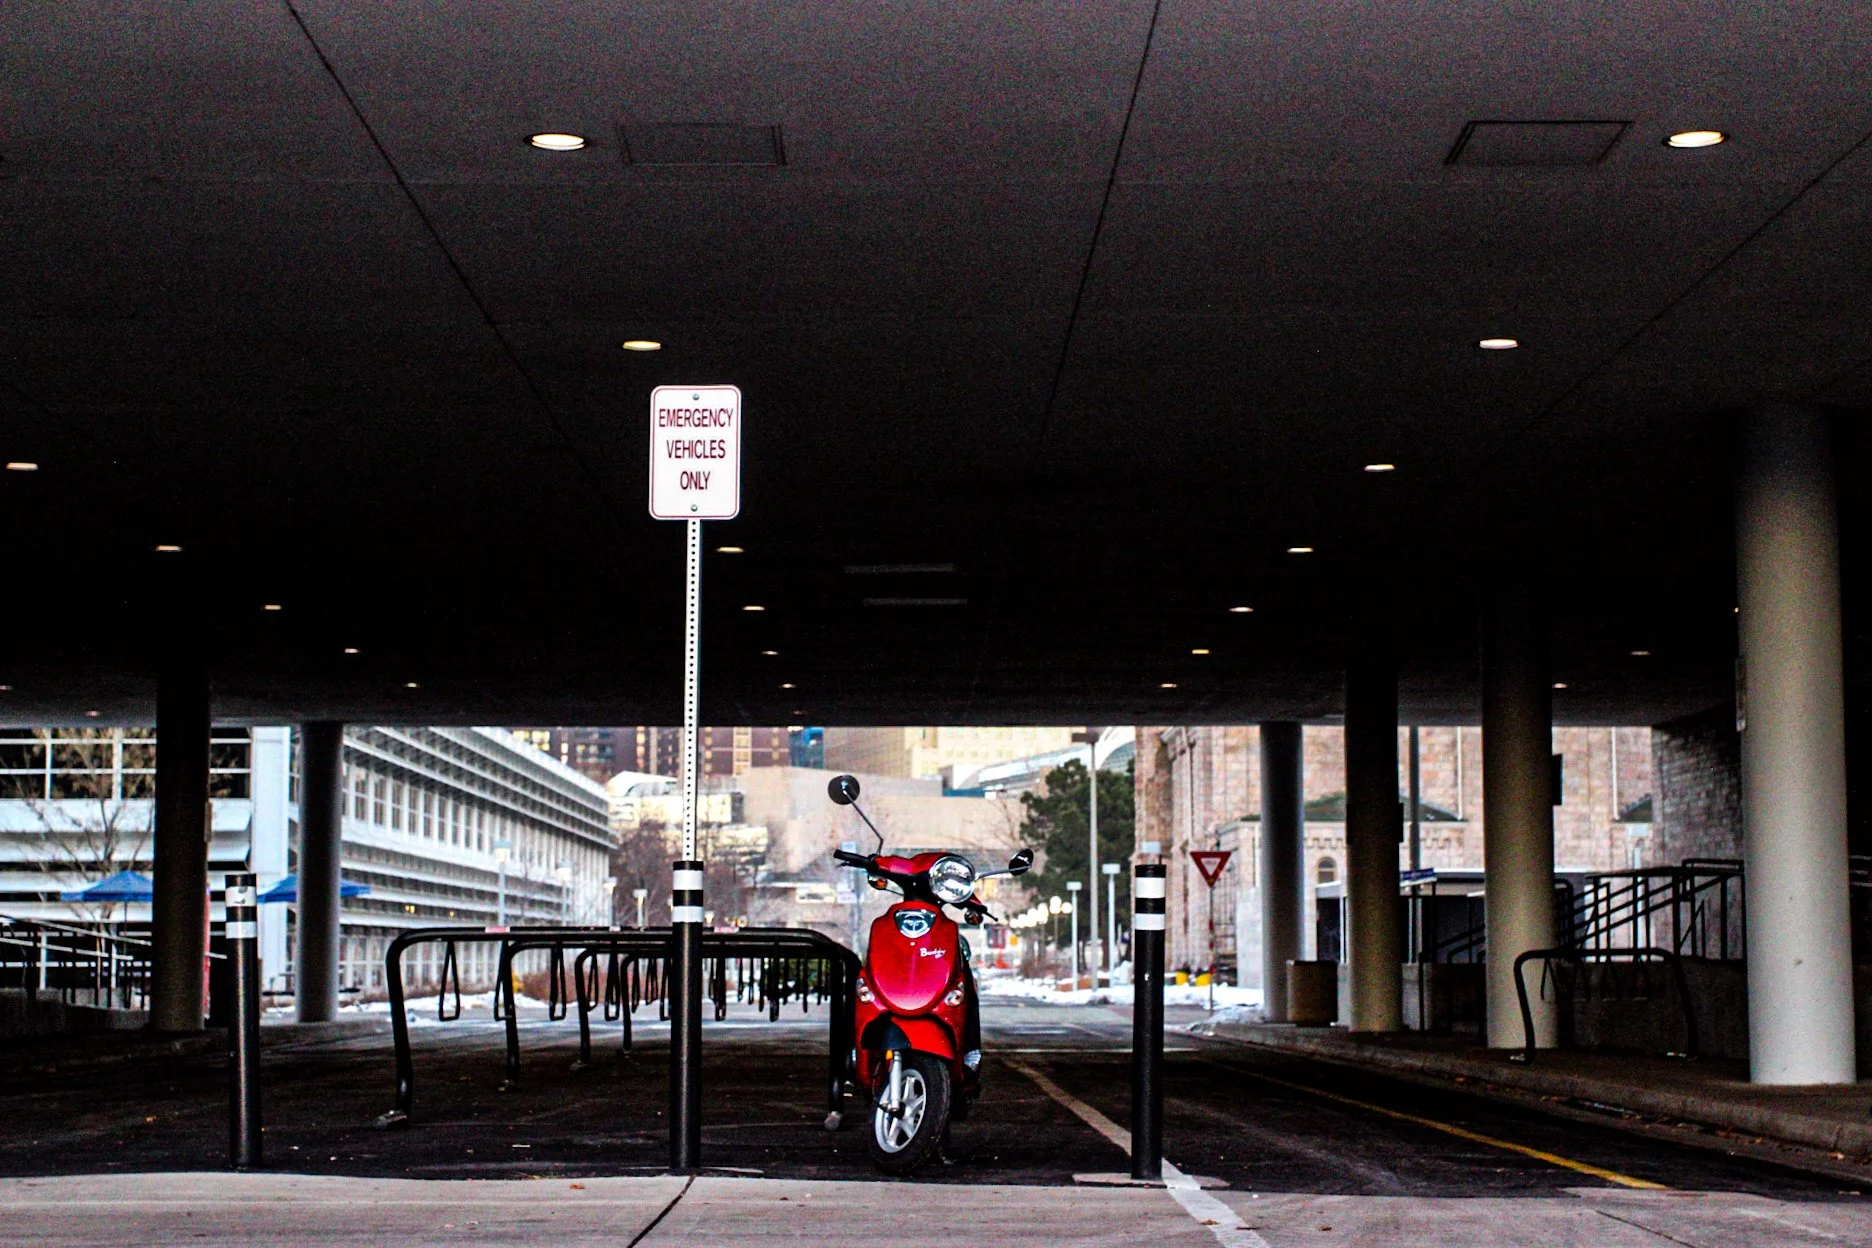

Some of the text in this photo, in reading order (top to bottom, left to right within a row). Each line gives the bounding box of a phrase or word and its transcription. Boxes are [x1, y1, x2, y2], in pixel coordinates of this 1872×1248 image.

[658, 408, 734, 428] EMERGENCY
[666, 439, 726, 459] VEHICLES
[680, 470, 711, 490] ONLY
